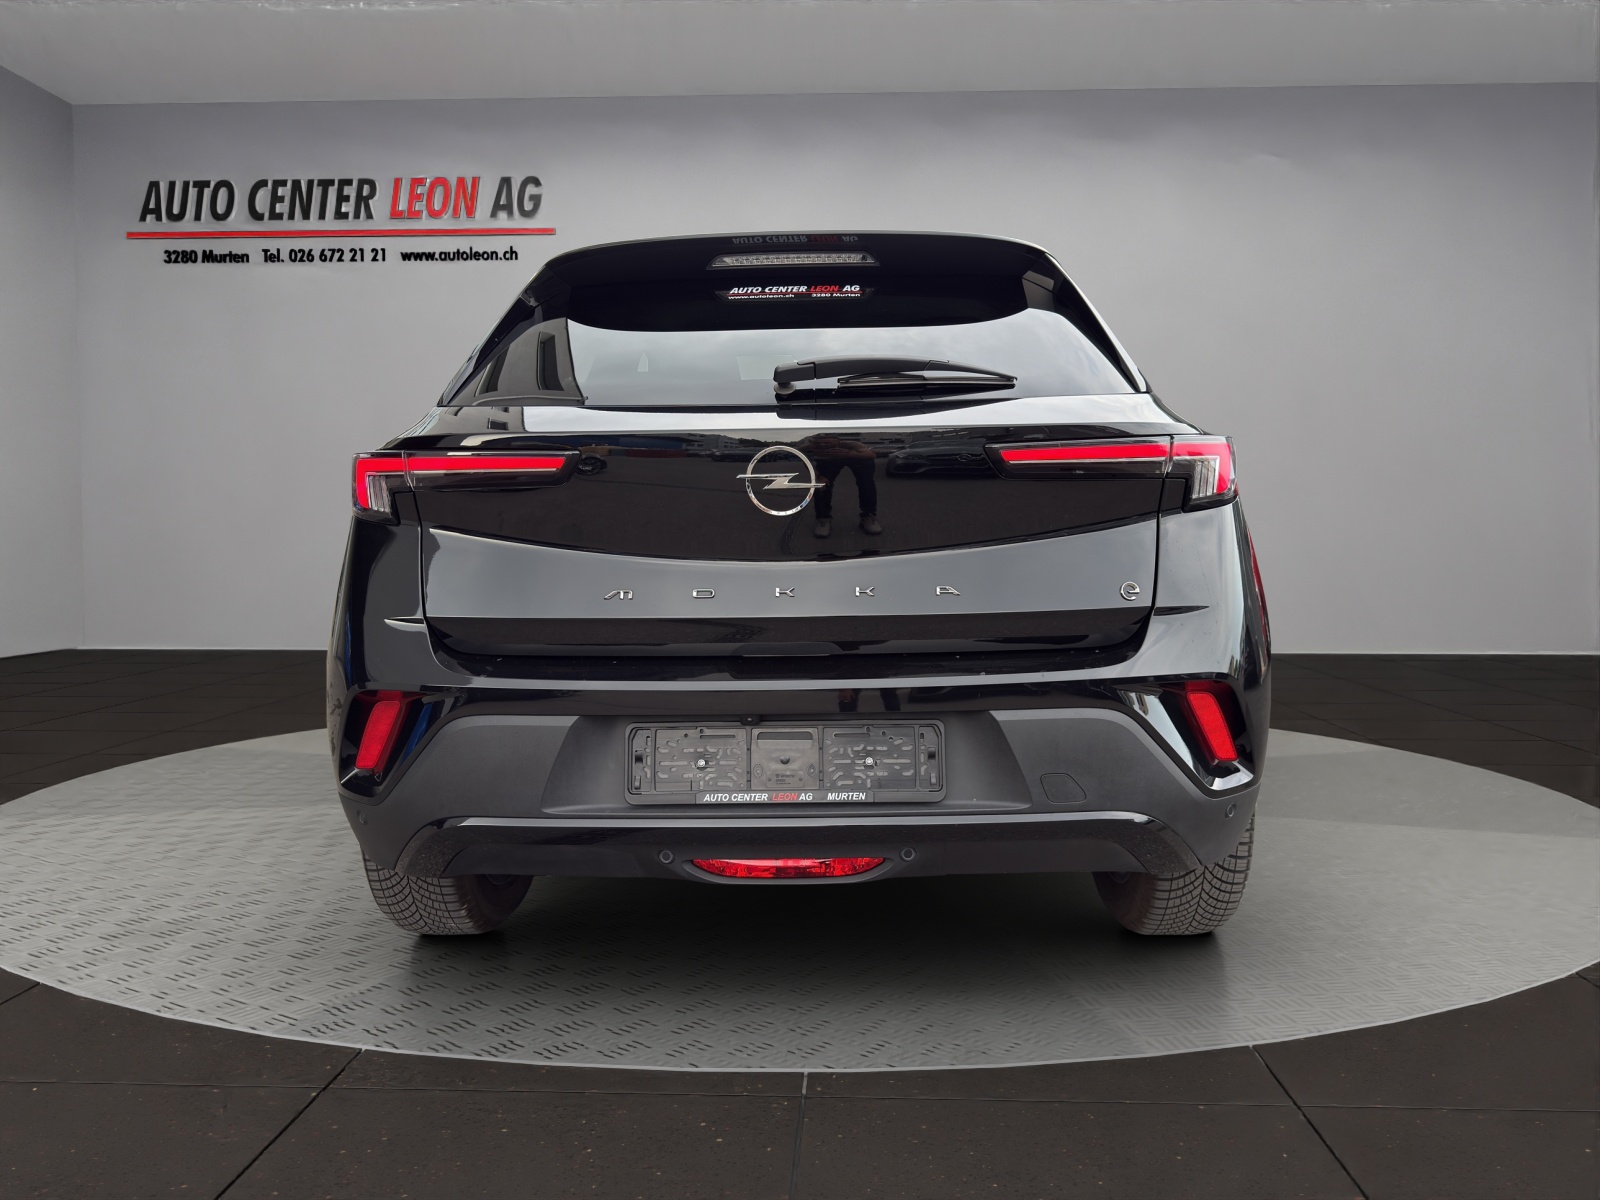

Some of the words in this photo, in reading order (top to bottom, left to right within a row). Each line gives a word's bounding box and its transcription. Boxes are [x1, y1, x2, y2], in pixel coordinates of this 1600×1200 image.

[139, 179, 235, 222] AUTO
[247, 178, 377, 221] CENTER
[390, 176, 480, 219] LEON
[490, 175, 543, 219] AG
[163, 250, 198, 264] 3280
[201, 249, 250, 264] Murten
[261, 248, 285, 263] Tel.
[288, 248, 315, 262] 026
[319, 248, 344, 262] 672
[349, 248, 365, 262] 21
[370, 248, 386, 262] 21
[400, 246, 519, 262] www.autoleon.ch
[729, 286, 762, 294] AUTO
[764, 285, 808, 293] CENTER
[842, 284, 860, 292] AG
[604, 585, 961, 601] MOKKA
[703, 793, 731, 802] AUTO
[731, 793, 768, 802] CENTER
[772, 792, 798, 801] LEON
[798, 792, 813, 801] AG
[827, 792, 866, 801] MURTEN
